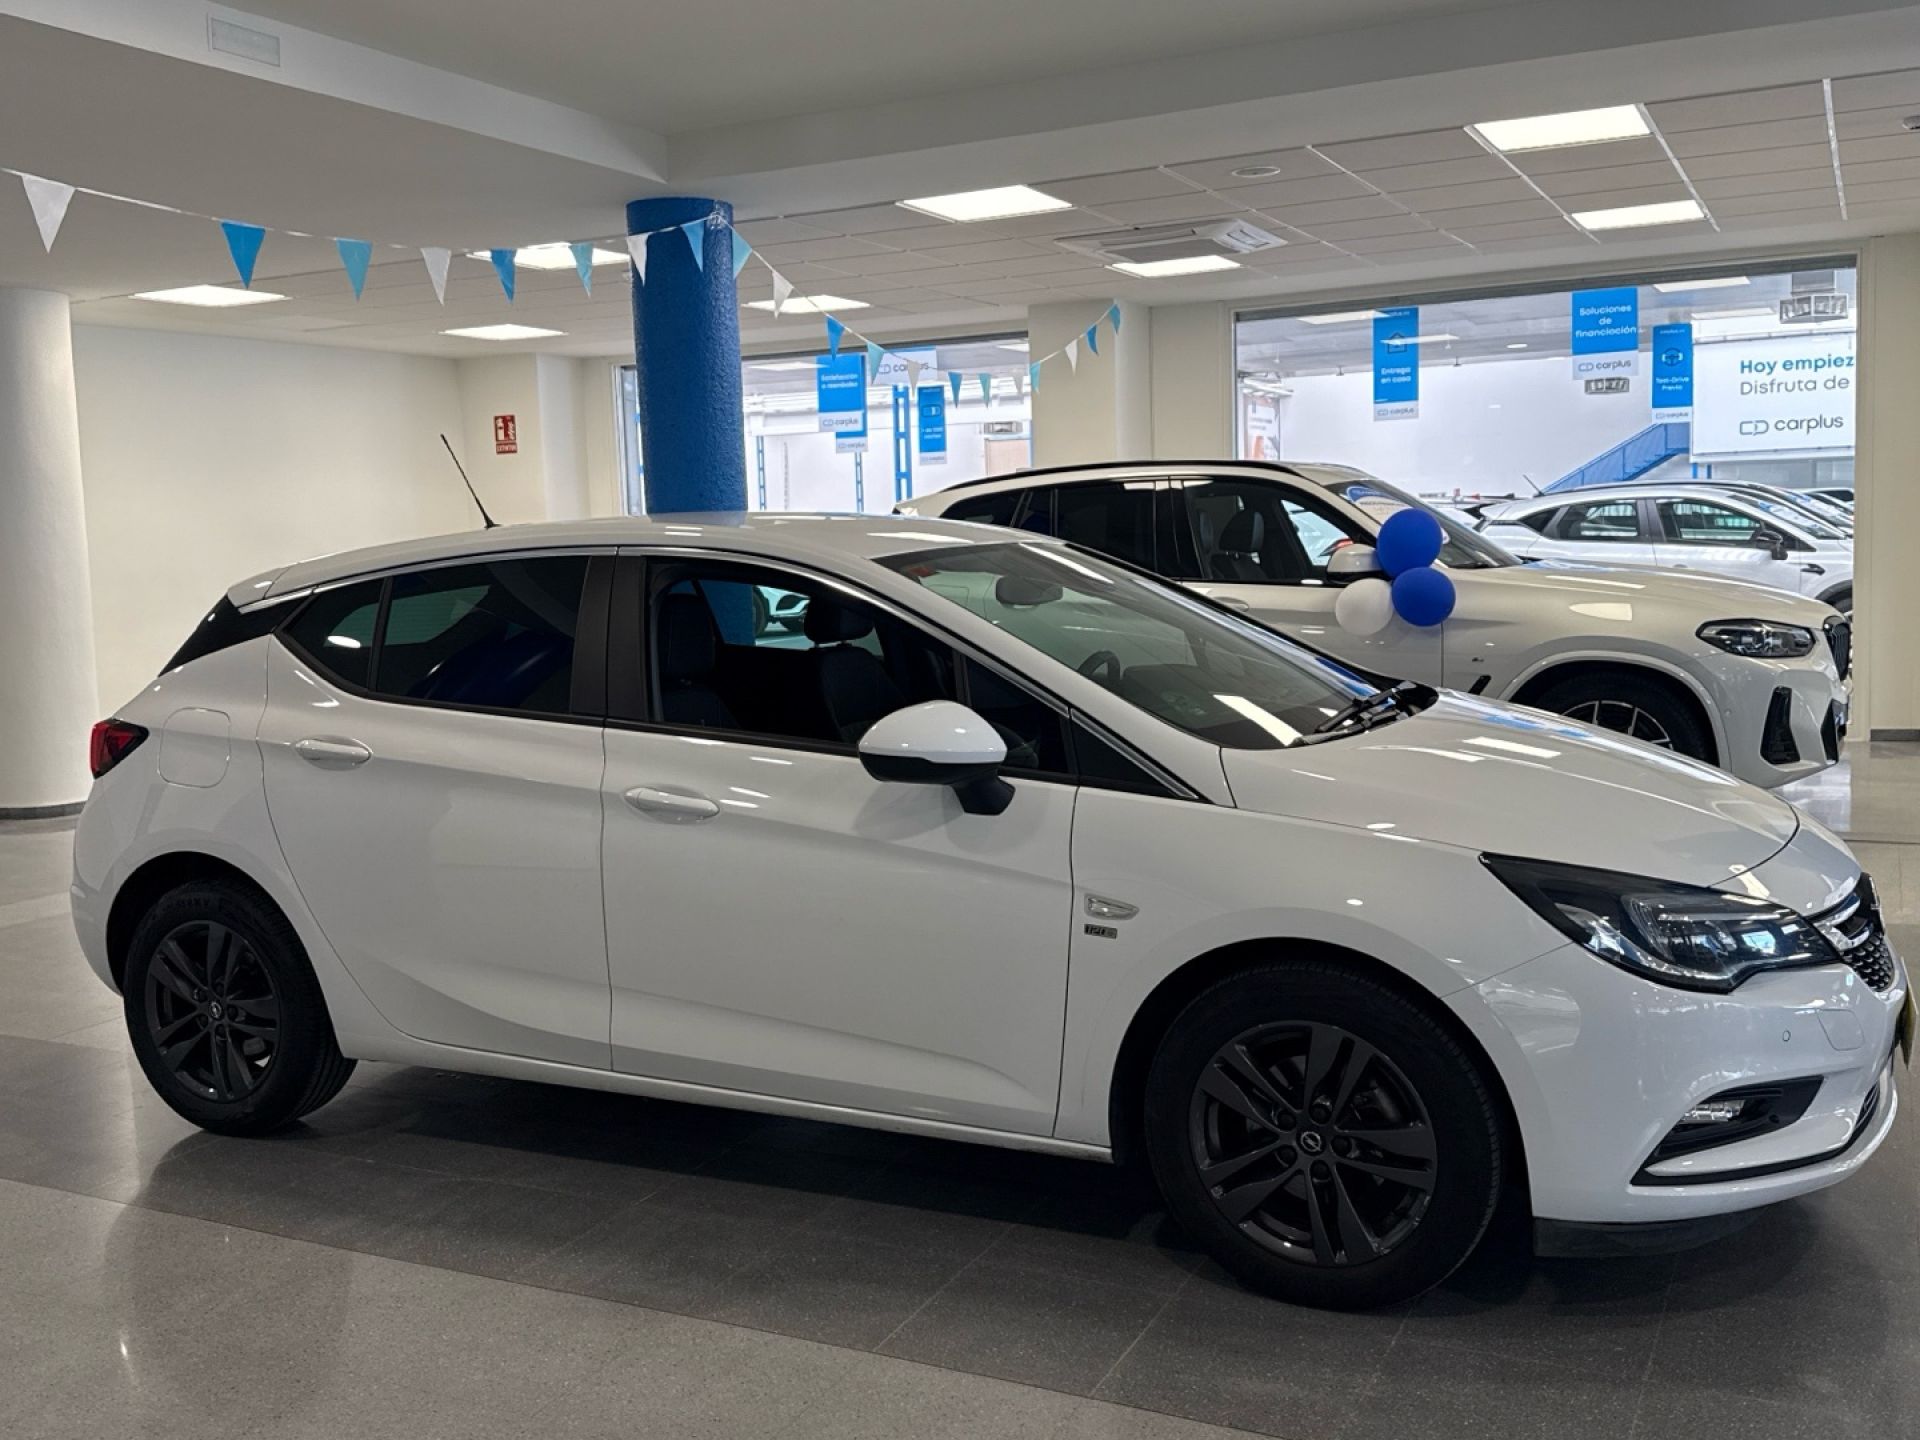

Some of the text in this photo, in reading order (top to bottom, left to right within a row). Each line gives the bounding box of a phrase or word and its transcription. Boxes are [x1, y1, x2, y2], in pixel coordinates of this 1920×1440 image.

[1579, 304, 1632, 316] Soluciones
[1599, 317, 1612, 325] de
[1595, 360, 1631, 370] carplus
[1740, 354, 1854, 375] Hoy empiez
[1740, 375, 1850, 395] Disfruta de
[834, 418, 858, 427] carplus
[1774, 414, 1844, 435] carplus
